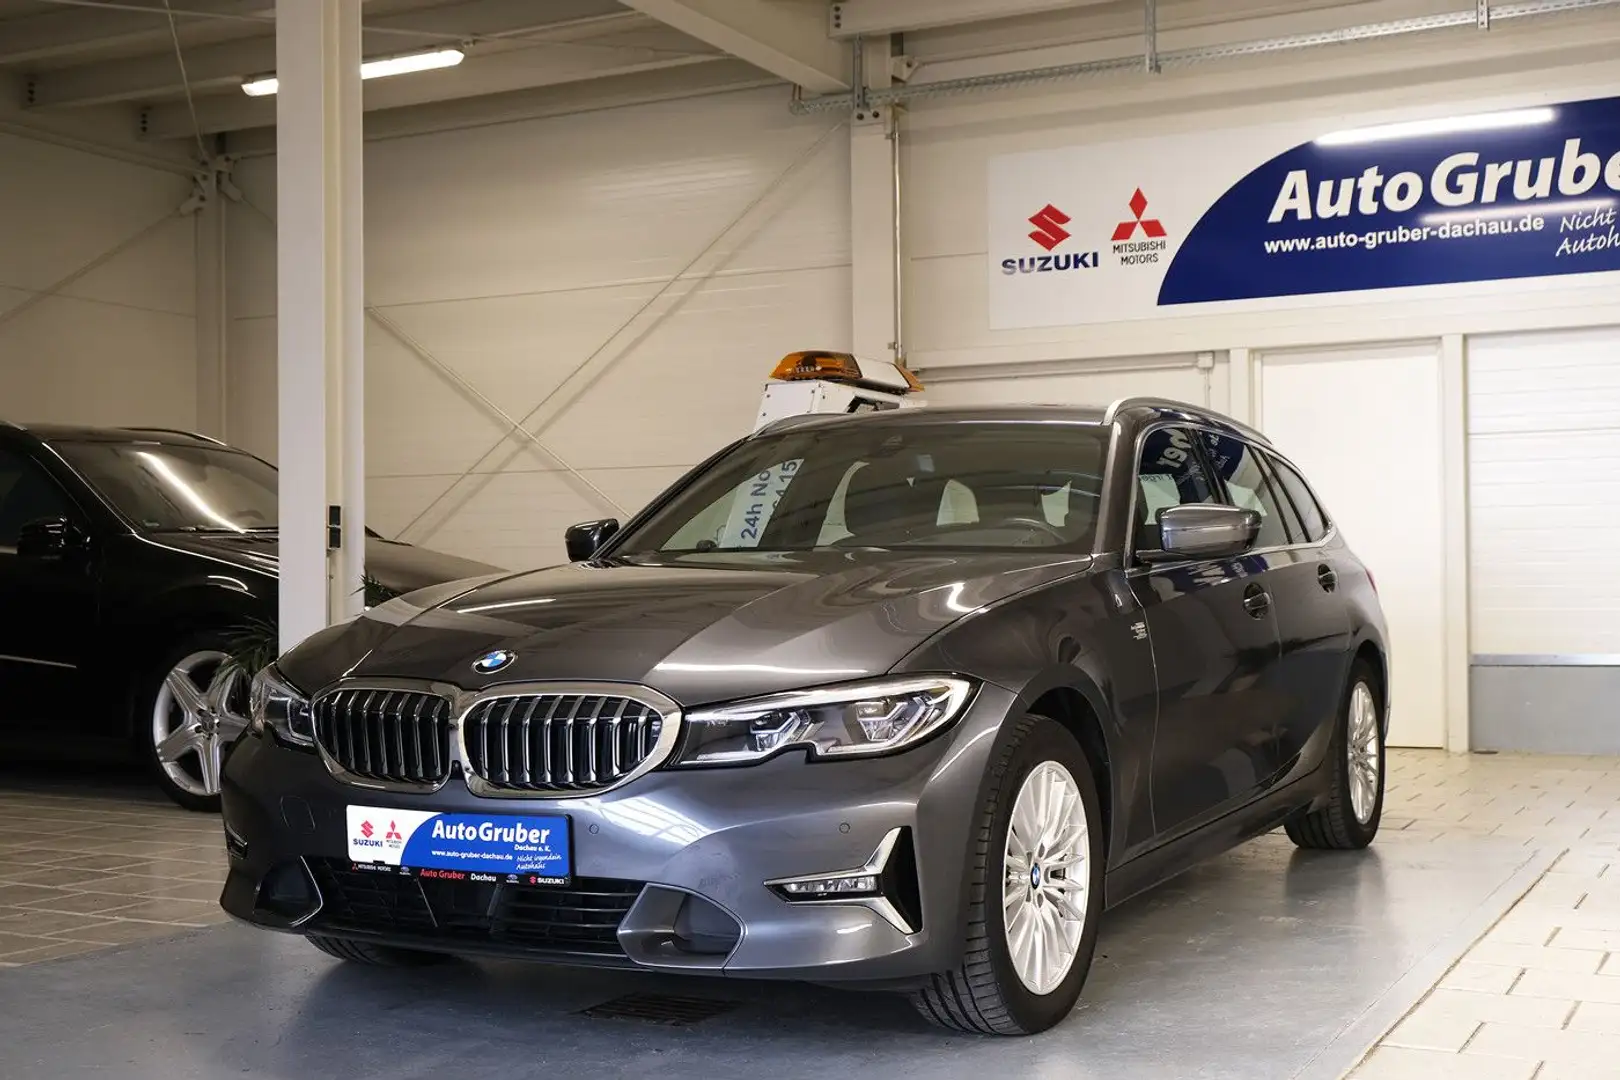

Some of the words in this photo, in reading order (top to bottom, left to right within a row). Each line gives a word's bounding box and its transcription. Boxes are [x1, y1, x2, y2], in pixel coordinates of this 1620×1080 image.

[1560, 204, 1617, 233] Nicht
[1264, 214, 1545, 253] www.auto-gruber-dachau.de
[1113, 240, 1166, 254] MITSUBISHI
[1001, 252, 1099, 275] SUZUKI
[1120, 253, 1159, 266] MOTORS
[779, 461, 798, 483] 15
[740, 503, 763, 540] 24h
[353, 838, 383, 848] SUZUKI
[431, 850, 513, 861] www.auto-gruber-dachau.de
[420, 868, 438, 878] Auto
[439, 870, 465, 880] Gruber
[470, 873, 497, 882] Dachau
[537, 877, 565, 885] SUZUKI
